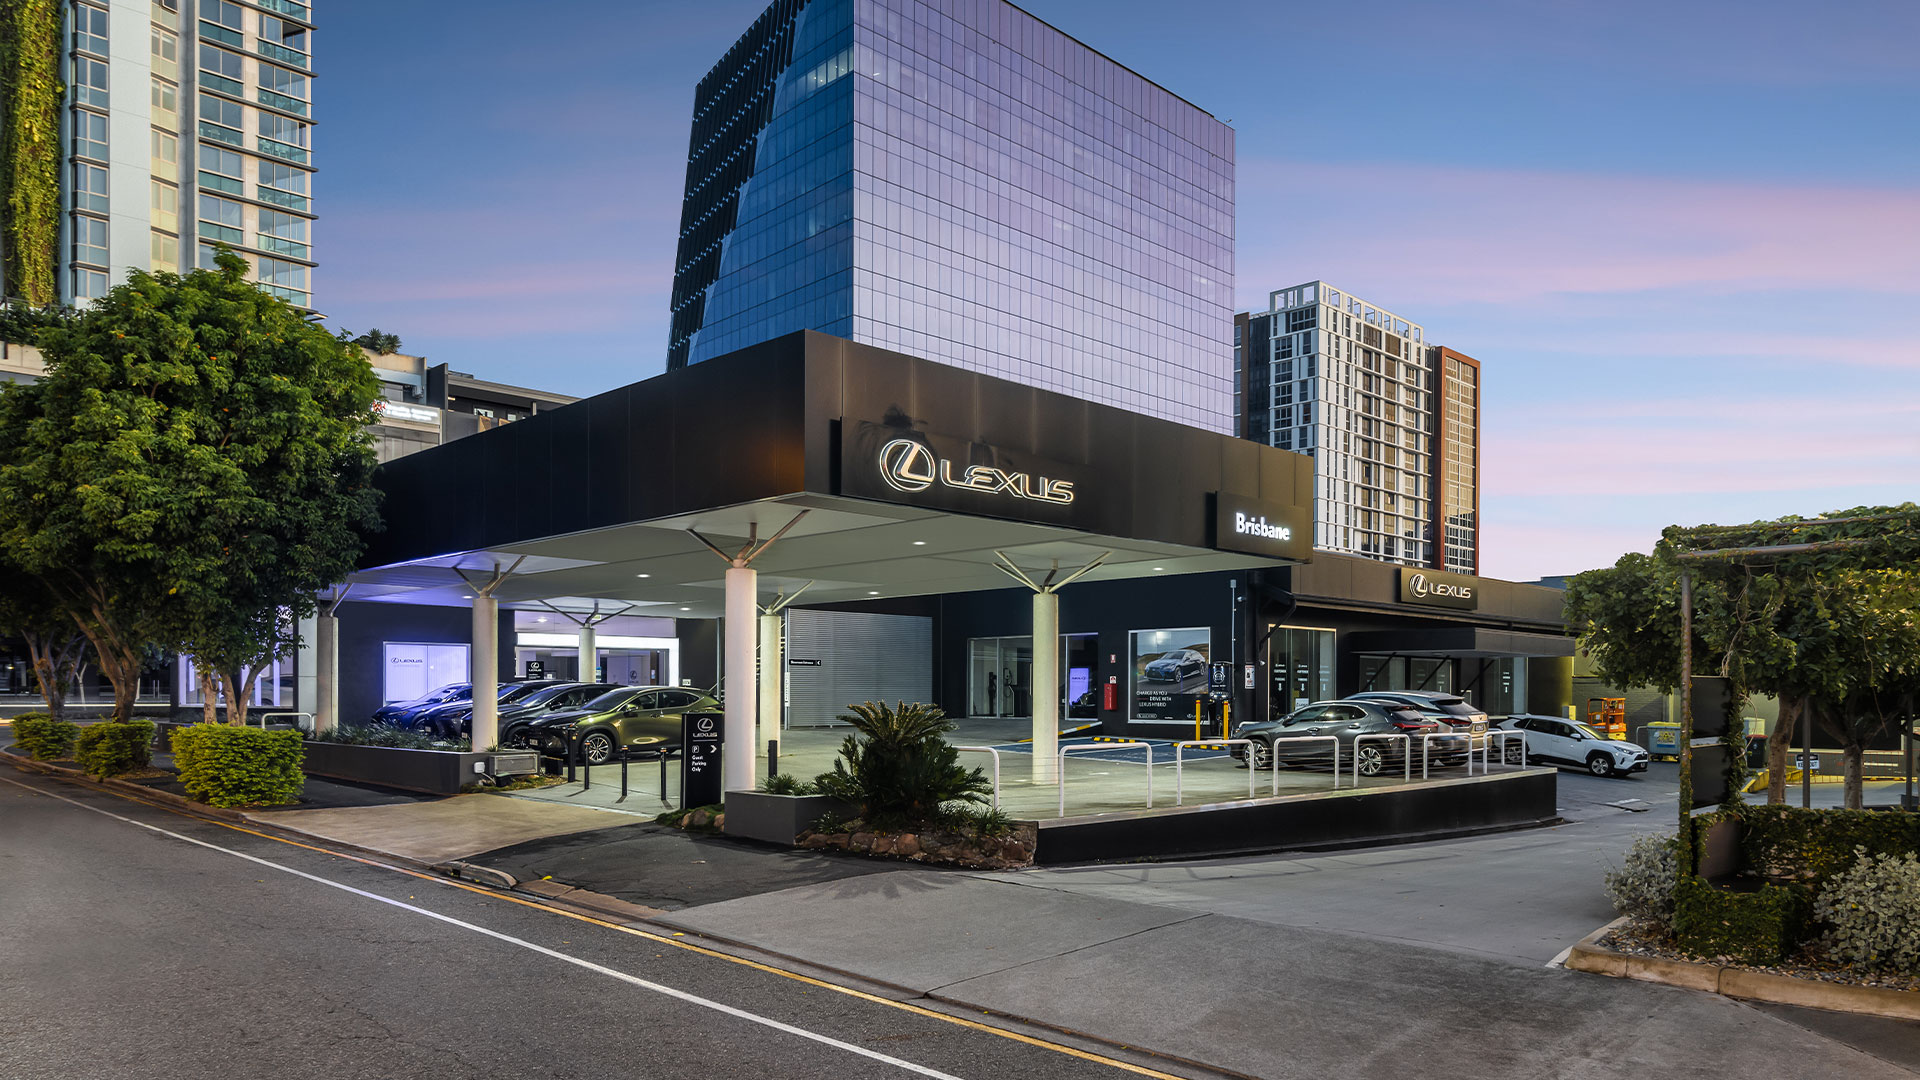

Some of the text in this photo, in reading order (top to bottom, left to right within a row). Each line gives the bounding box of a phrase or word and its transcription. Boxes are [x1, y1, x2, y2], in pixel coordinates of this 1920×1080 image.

[940, 459, 1074, 505] LEXUS
[1235, 512, 1290, 541] Brisbane
[1429, 582, 1471, 599] LEXUS
